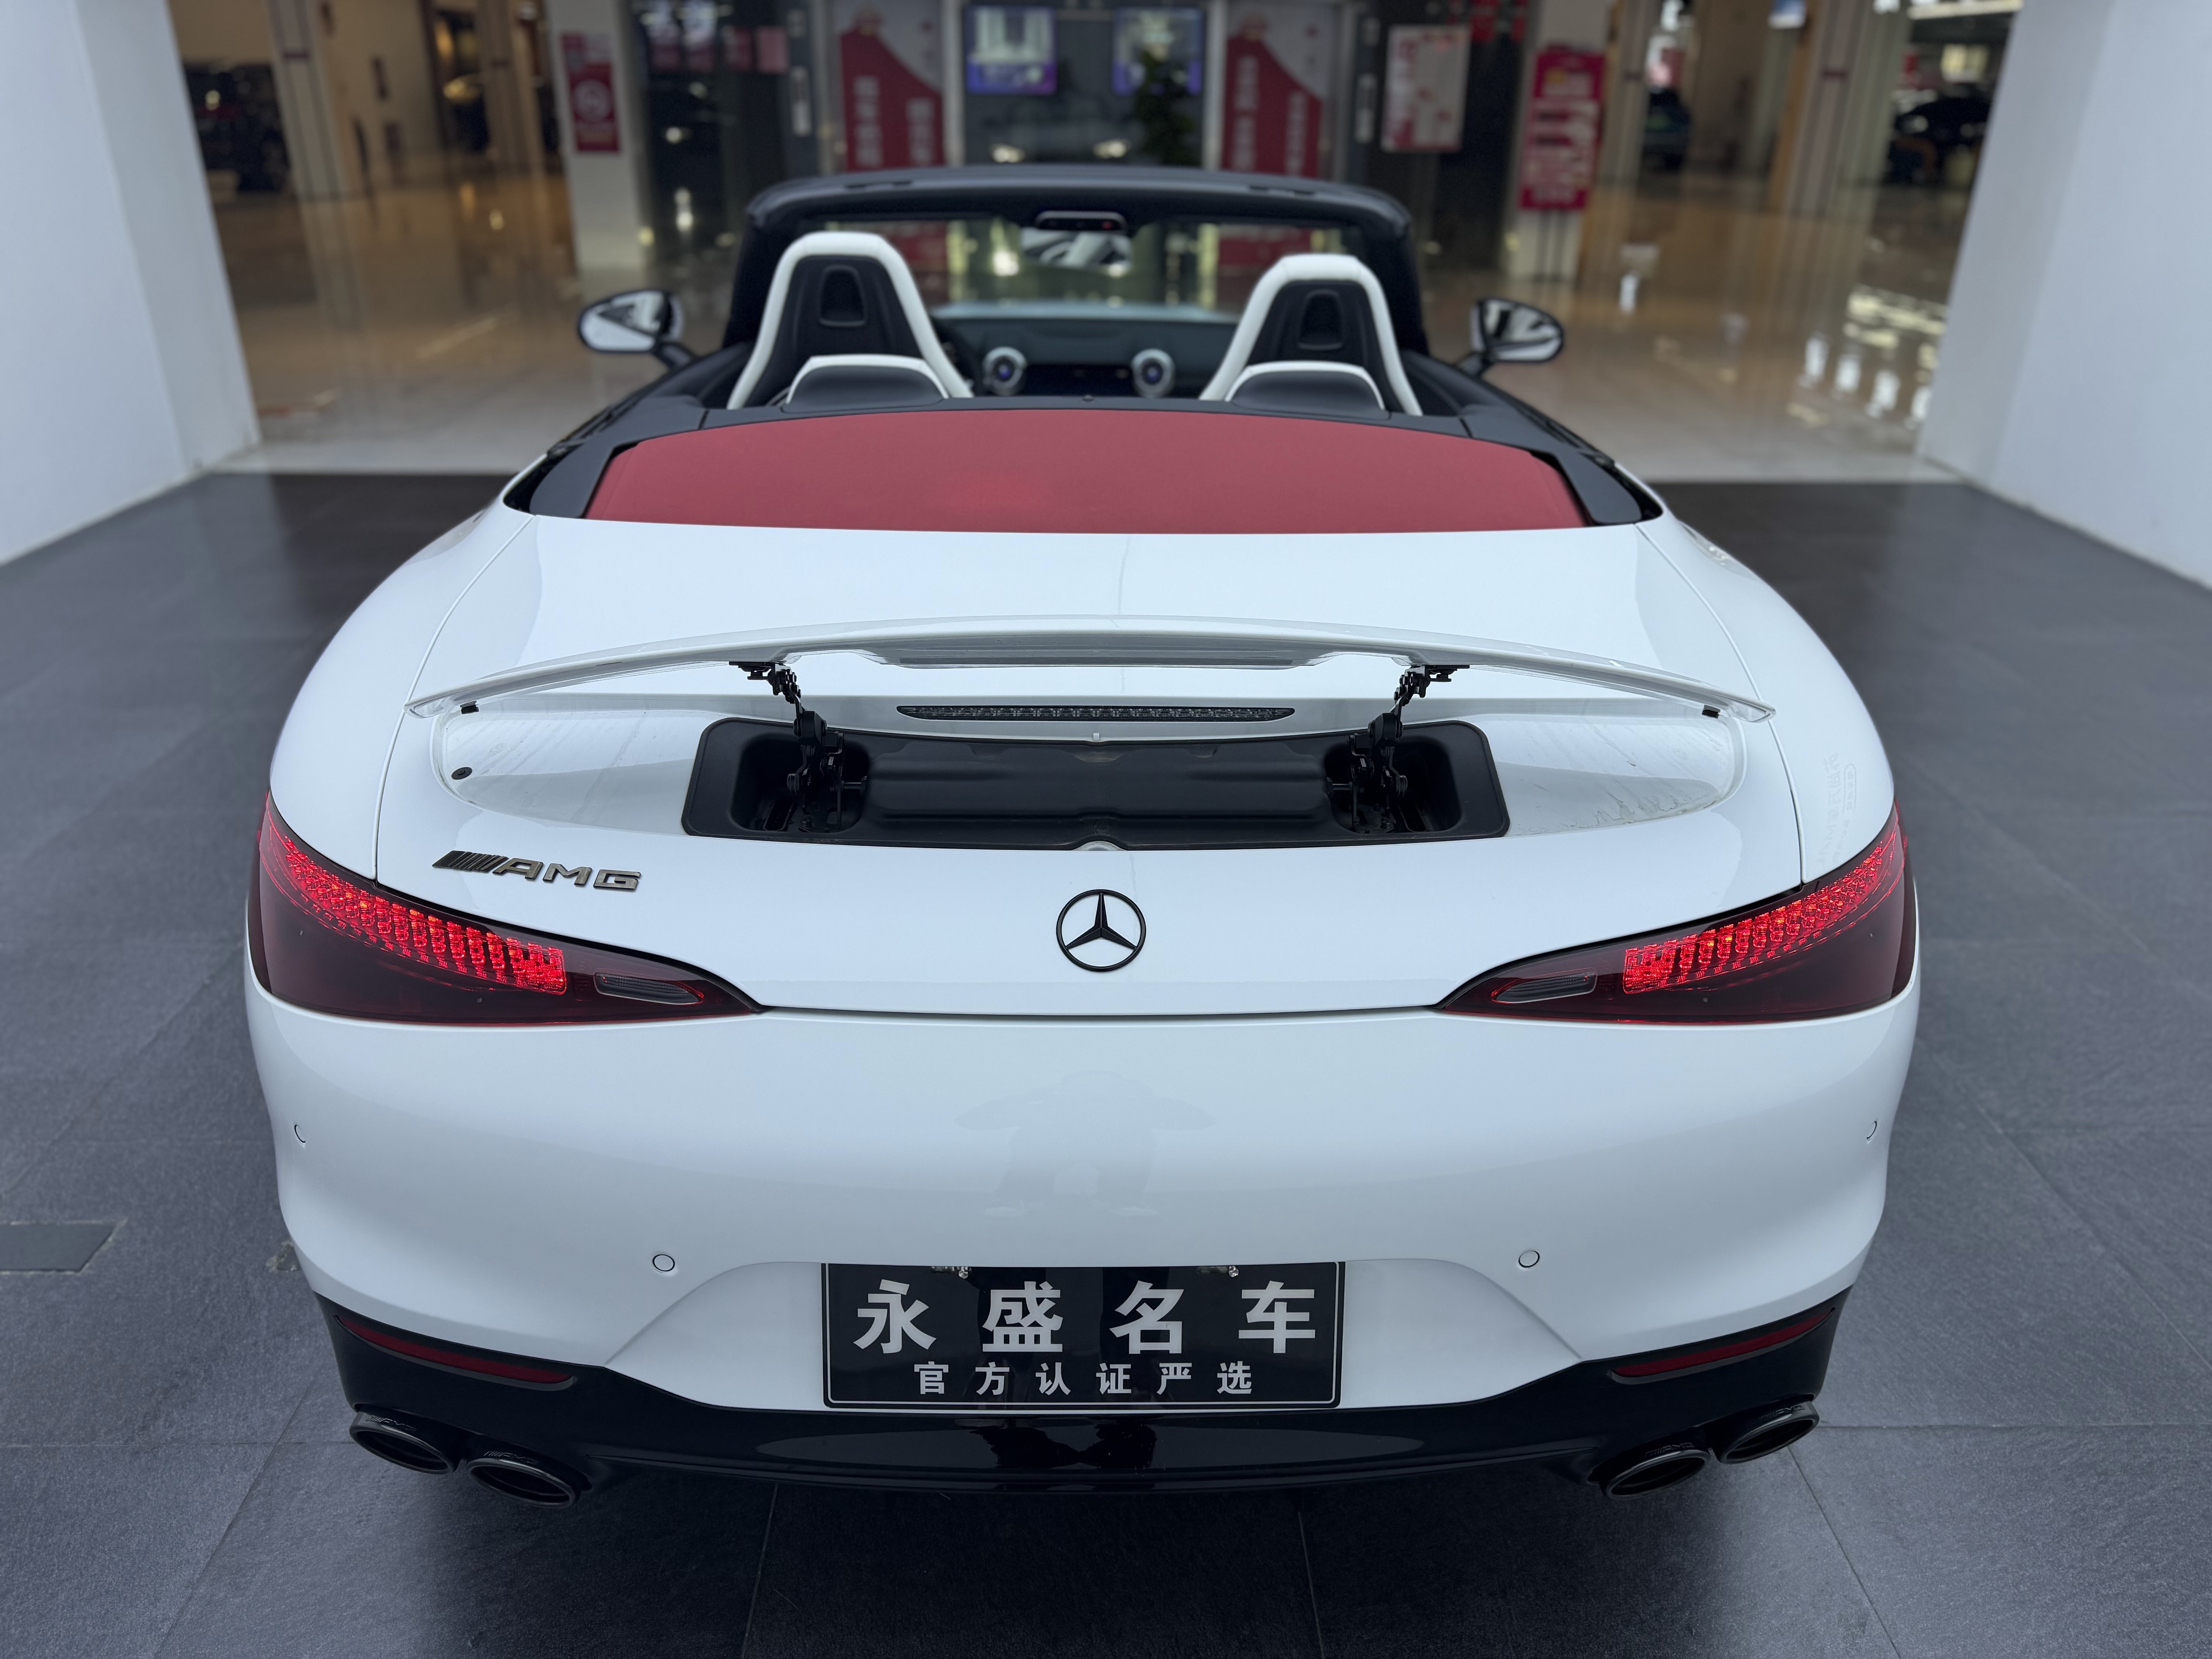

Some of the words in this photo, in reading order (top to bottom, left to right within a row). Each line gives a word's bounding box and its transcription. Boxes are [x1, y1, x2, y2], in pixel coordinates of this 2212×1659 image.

[492, 857, 641, 892] AMG
[853, 1279, 1316, 1354] 永盛名车
[914, 1360, 1252, 1395] 官方认证严选
